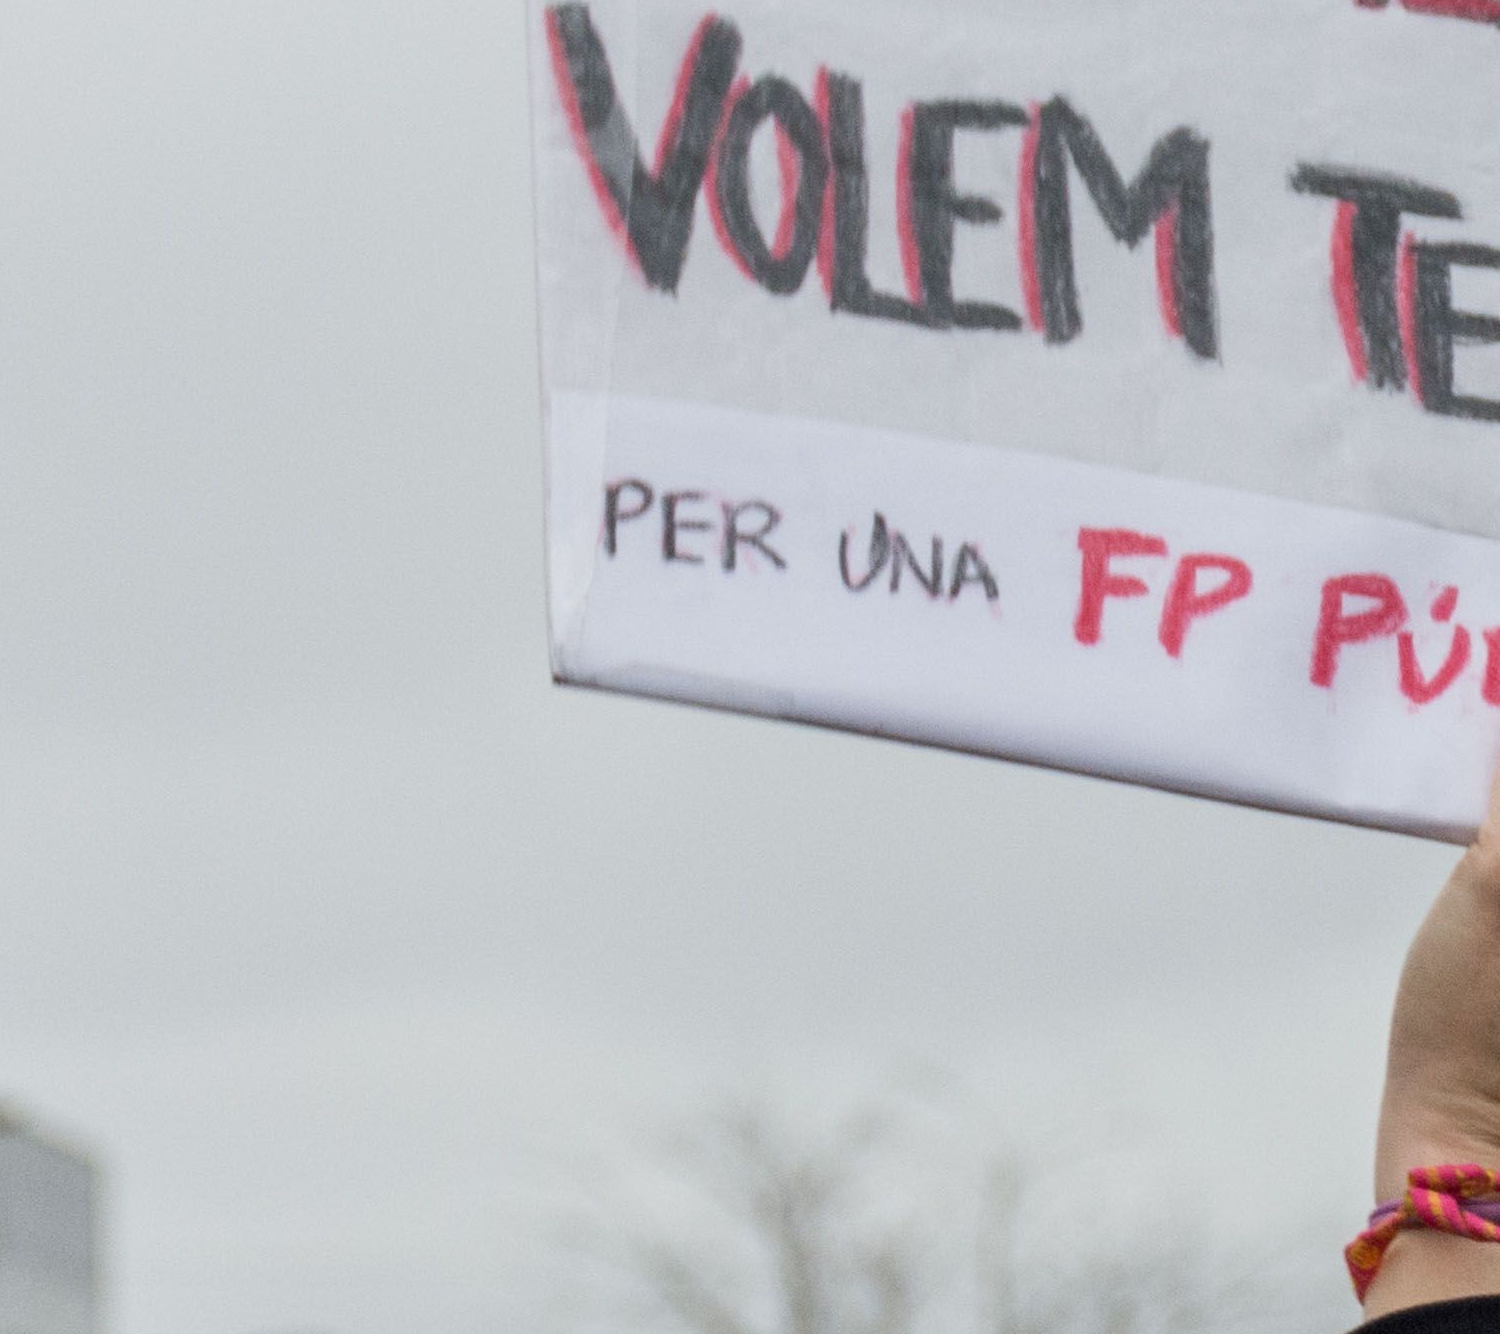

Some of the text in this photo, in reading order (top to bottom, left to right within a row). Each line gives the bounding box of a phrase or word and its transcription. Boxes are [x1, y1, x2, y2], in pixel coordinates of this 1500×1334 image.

[546, 1, 1218, 361] VOLEM
[598, 477, 789, 572] PER
[836, 509, 1002, 604] UNA
[1073, 527, 1255, 657] FP
